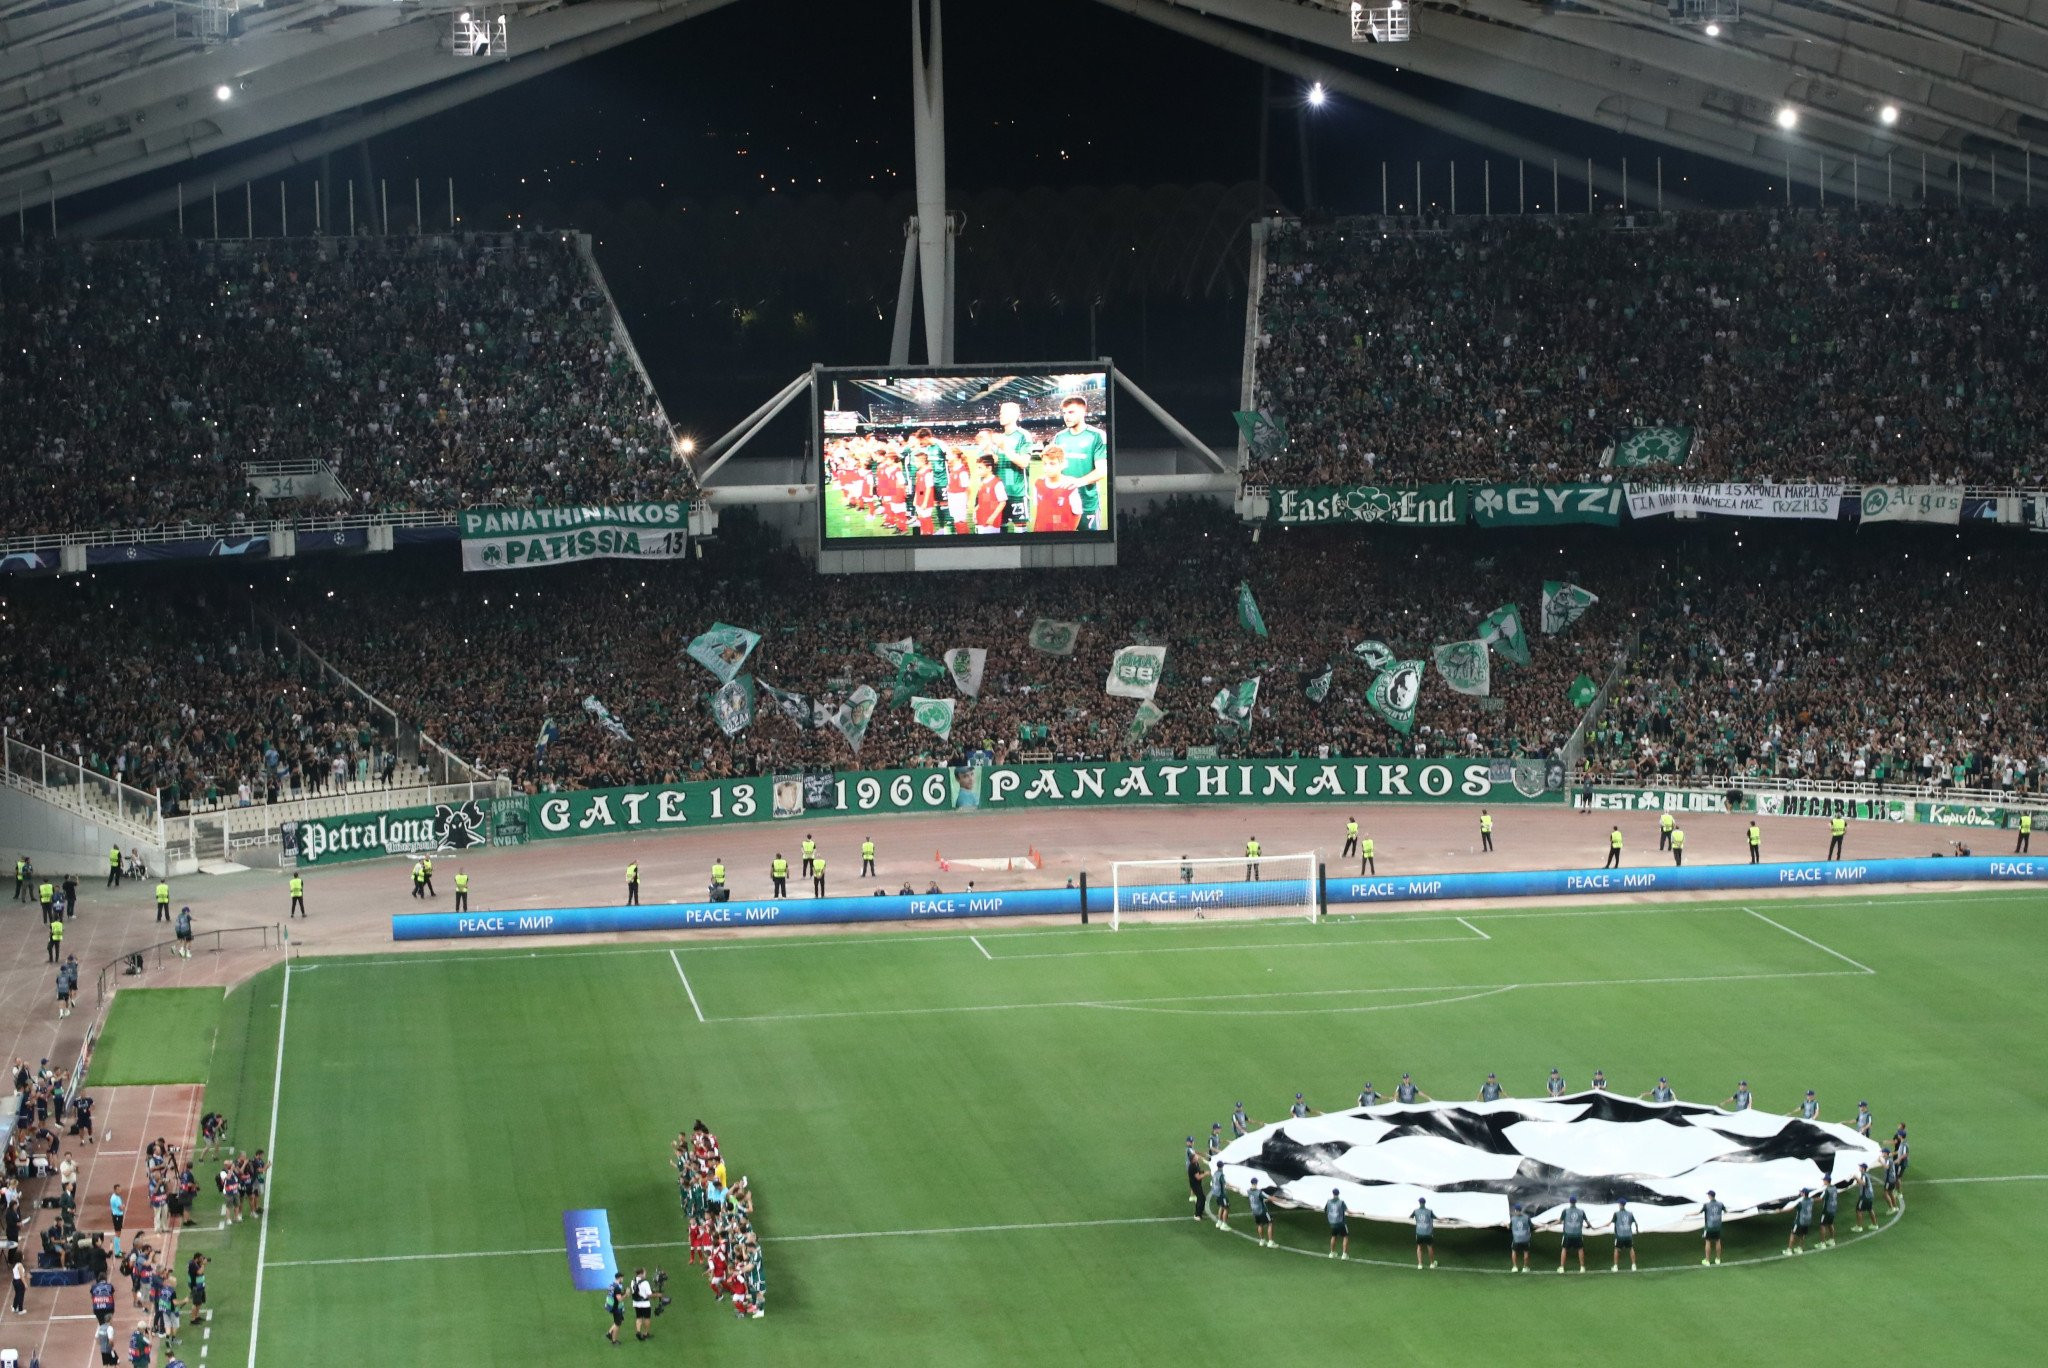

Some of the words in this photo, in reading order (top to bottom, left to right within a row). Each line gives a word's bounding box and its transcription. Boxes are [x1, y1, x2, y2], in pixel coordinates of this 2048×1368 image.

[271, 477, 293, 496] 34
[1725, 484, 1741, 496] 15
[1278, 488, 1342, 522] East
[1396, 490, 1456, 523] End
[1507, 487, 1622, 515] GYZI
[1741, 498, 1763, 510] ΜΑΣ
[466, 503, 680, 533] PANATHINAIKOS
[506, 530, 641, 565] PATISSIA
[664, 531, 684, 554] 13
[834, 773, 946, 810] 1966
[988, 764, 1492, 802] PANATHINAIKOS
[540, 791, 687, 832] GATE
[710, 784, 757, 818] 13
[303, 815, 435, 861] Petralona
[1780, 868, 1822, 882] PEACE
[1835, 867, 1867, 880] МИР
[1990, 862, 2033, 875] PEACE
[1351, 882, 1395, 897] PEACE
[1409, 881, 1442, 894] МИР
[1567, 874, 1610, 889] PEACE
[1623, 874, 1656, 887] МИР
[1132, 889, 1176, 904] PEACE
[1191, 888, 1224, 903] МИР
[910, 899, 955, 914] PEACE
[970, 897, 1003, 912] МИР
[686, 908, 731, 923] PEACE
[745, 906, 779, 920] МИР
[459, 917, 505, 932] PEACE
[520, 916, 553, 930] МИР
